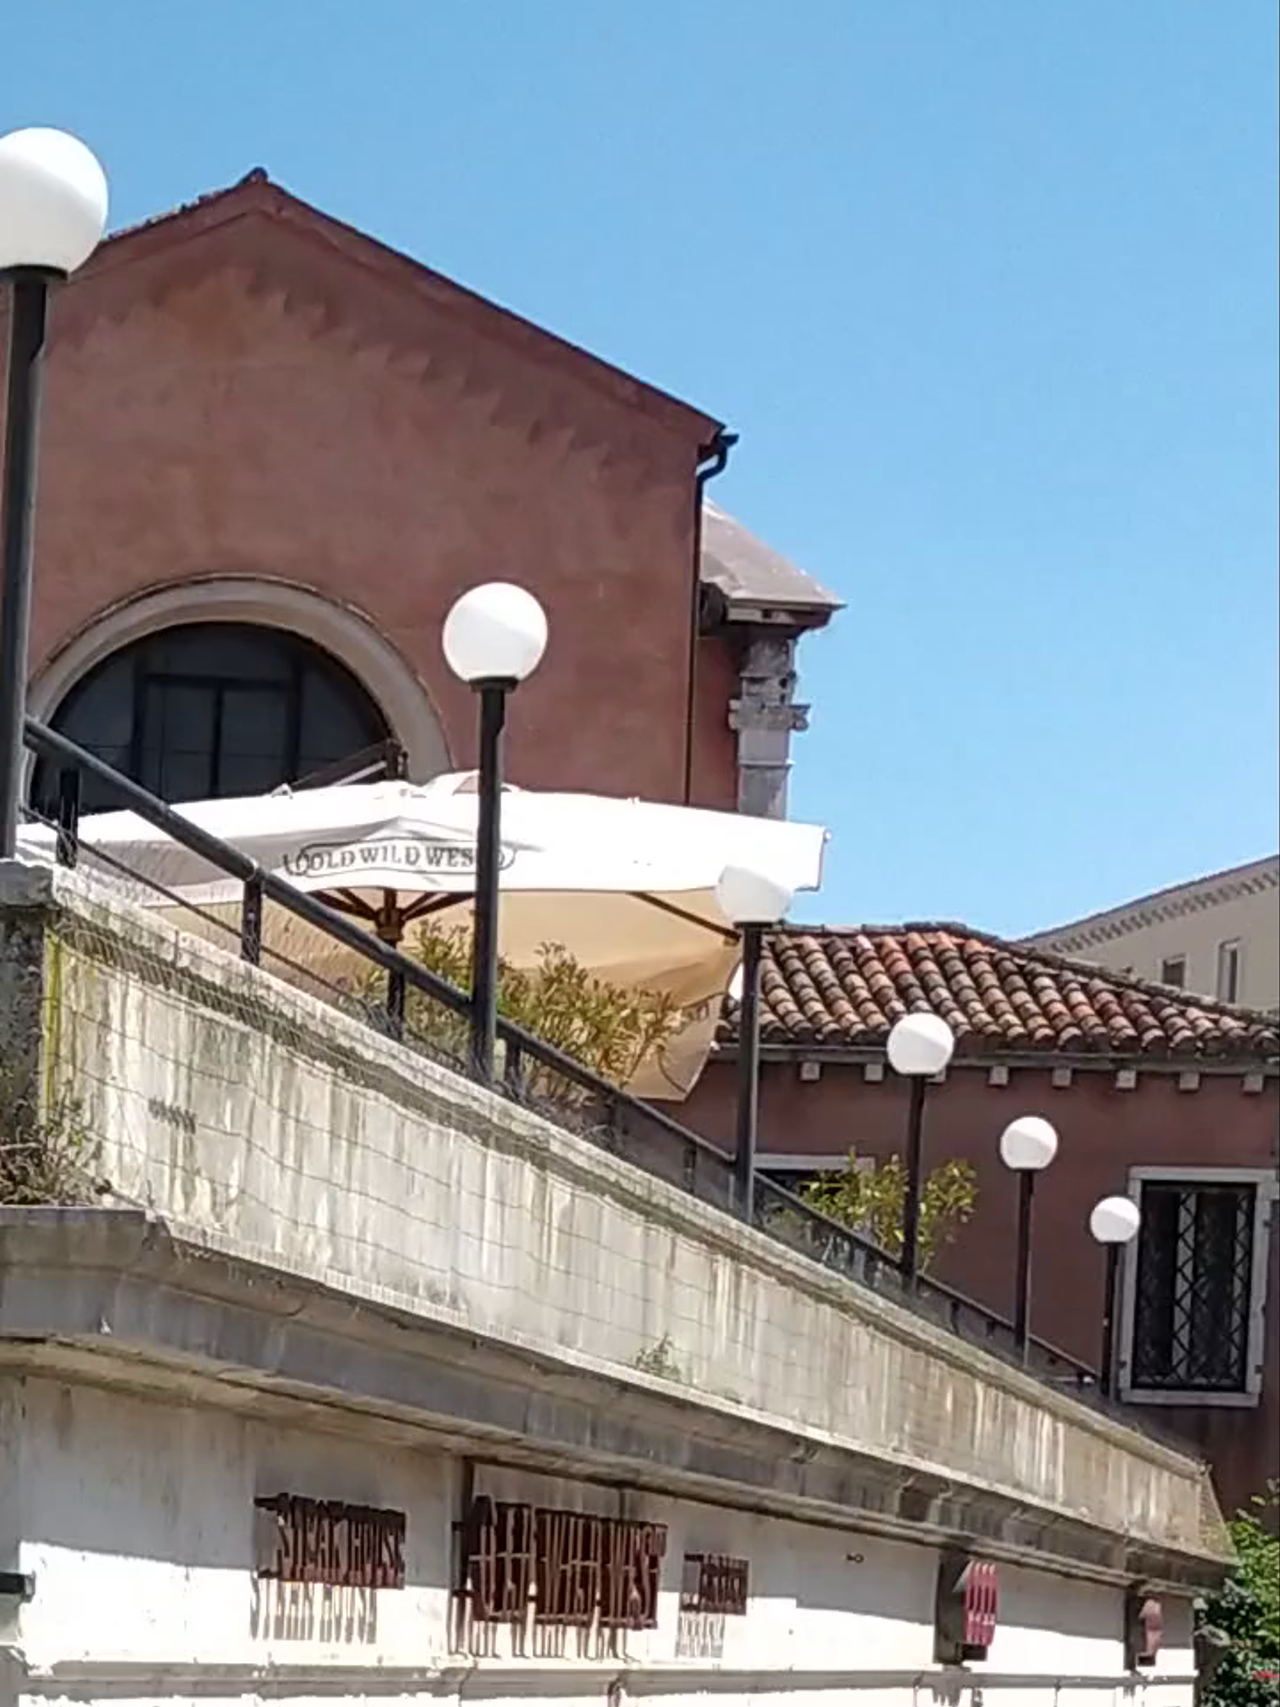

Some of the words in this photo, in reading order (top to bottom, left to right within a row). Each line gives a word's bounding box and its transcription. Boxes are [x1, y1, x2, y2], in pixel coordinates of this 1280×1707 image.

[309, 850, 356, 871] OLD
[359, 845, 421, 866] WILD
[425, 846, 475, 868] WES
